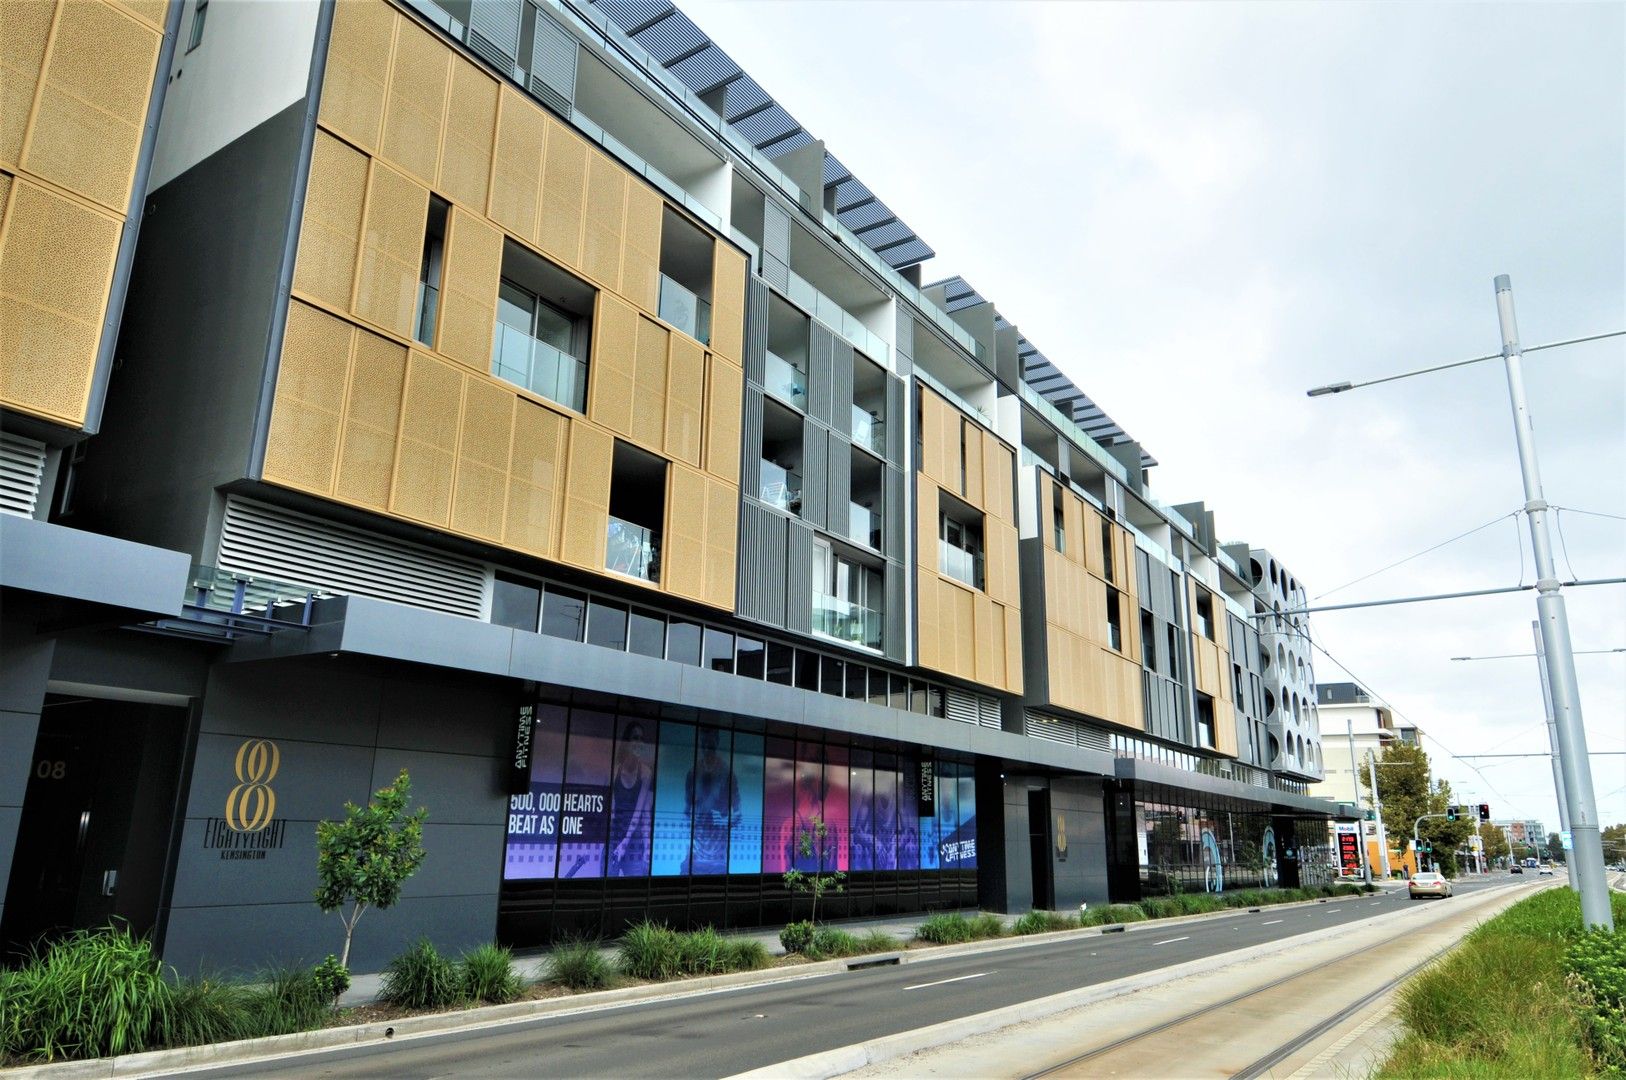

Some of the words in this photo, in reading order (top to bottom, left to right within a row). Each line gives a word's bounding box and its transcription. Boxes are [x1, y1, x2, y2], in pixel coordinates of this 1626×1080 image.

[515, 706, 527, 769] ANYTIME
[521, 706, 533, 768] FITNESS
[36, 760, 66, 780] 08
[538, 793, 561, 812] 000
[563, 793, 604, 813] HEARTS
[508, 814, 538, 834] BEAT
[540, 815, 555, 834] AS
[562, 816, 584, 835] ONE
[220, 850, 266, 861] KENSINGTON
